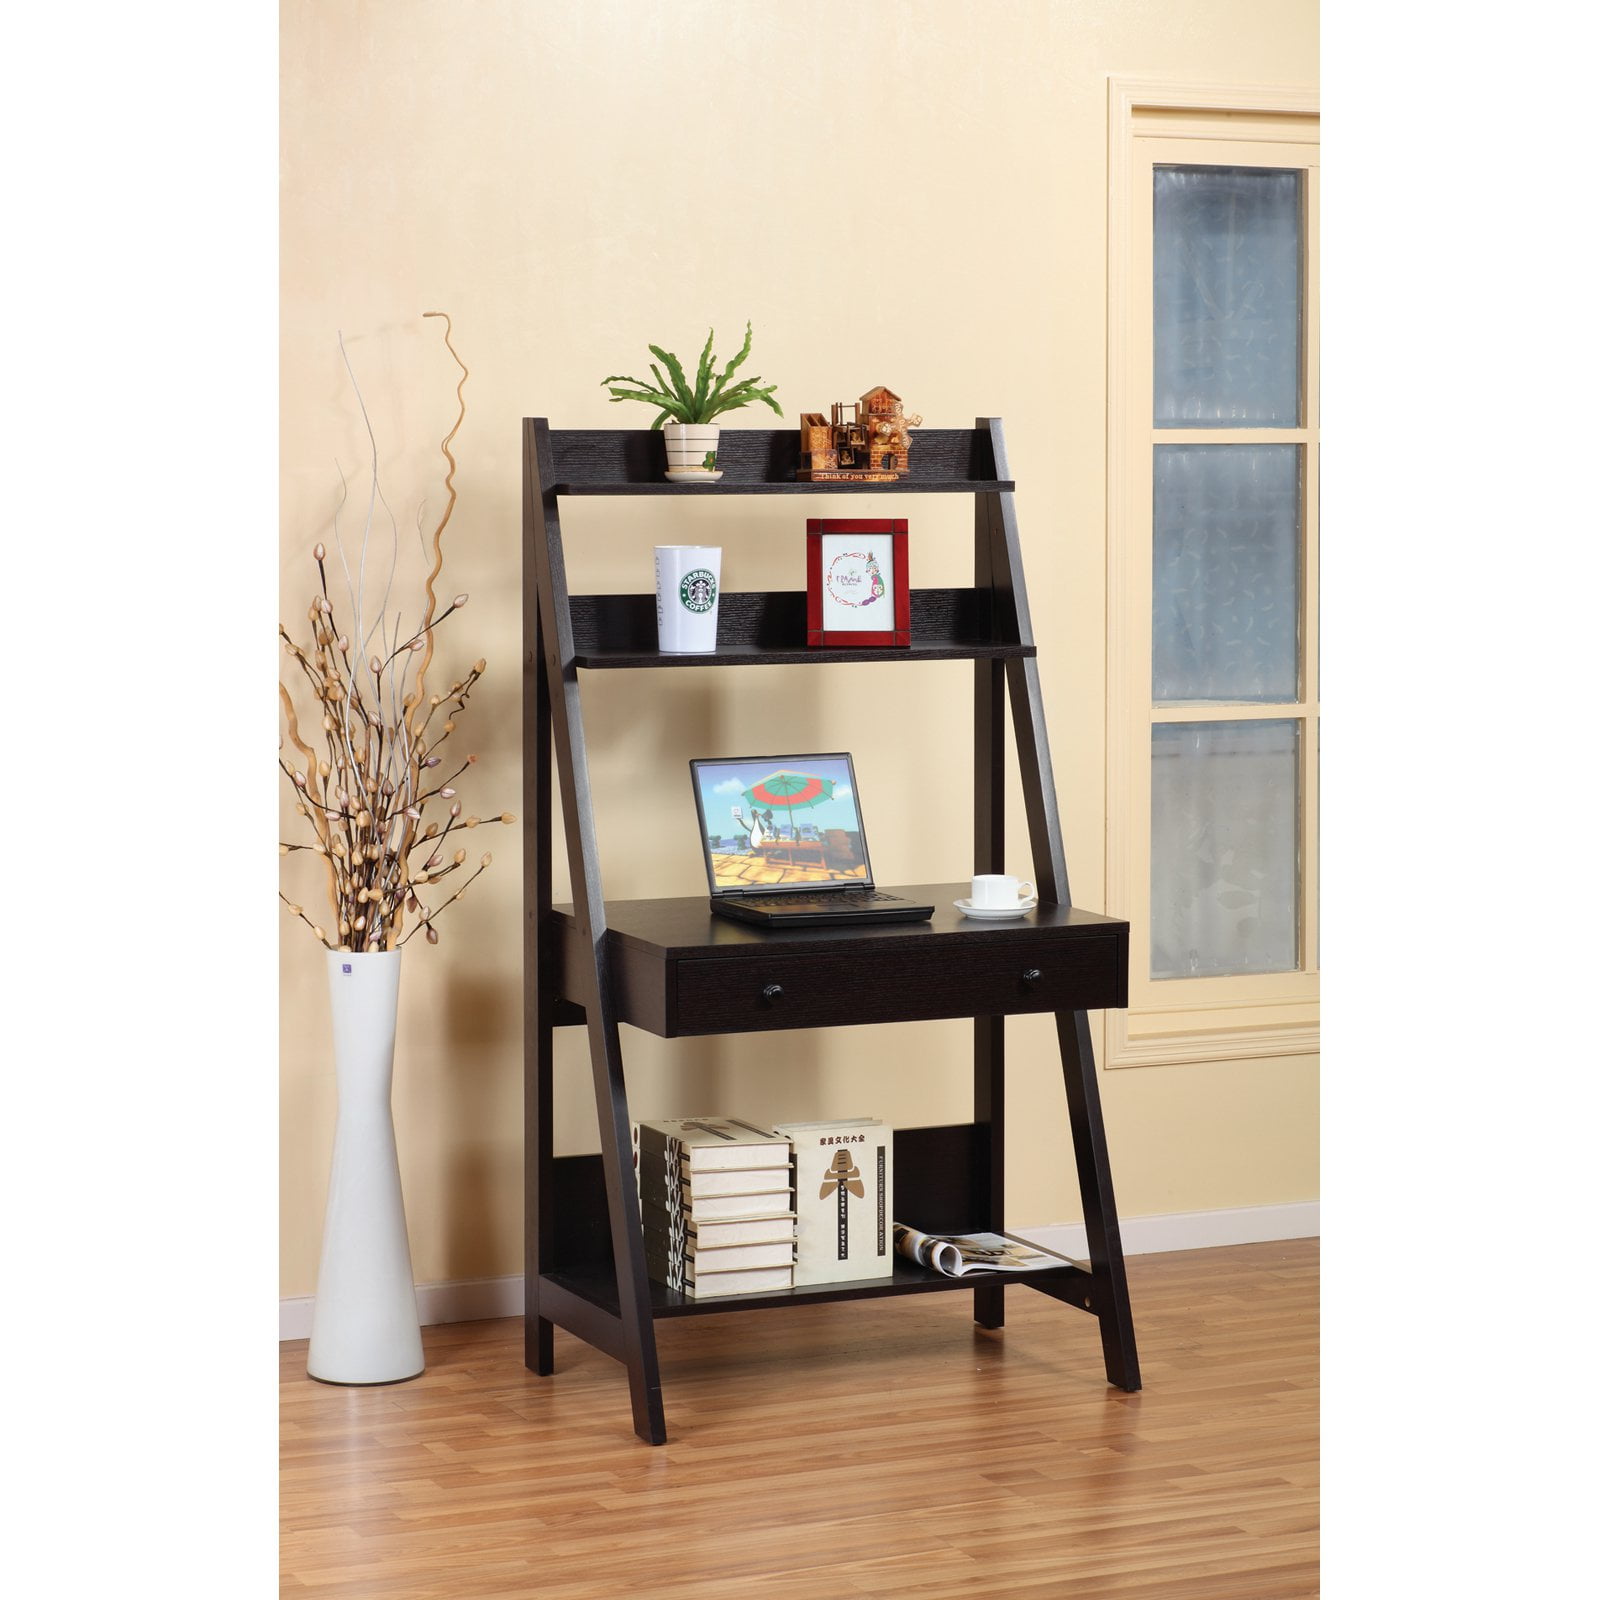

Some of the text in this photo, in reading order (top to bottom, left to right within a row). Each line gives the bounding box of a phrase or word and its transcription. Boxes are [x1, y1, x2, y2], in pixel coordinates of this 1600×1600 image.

[819, 472, 840, 480] Think
[681, 571, 716, 590] STARBUCKS
[685, 600, 712, 612] COFFEE
